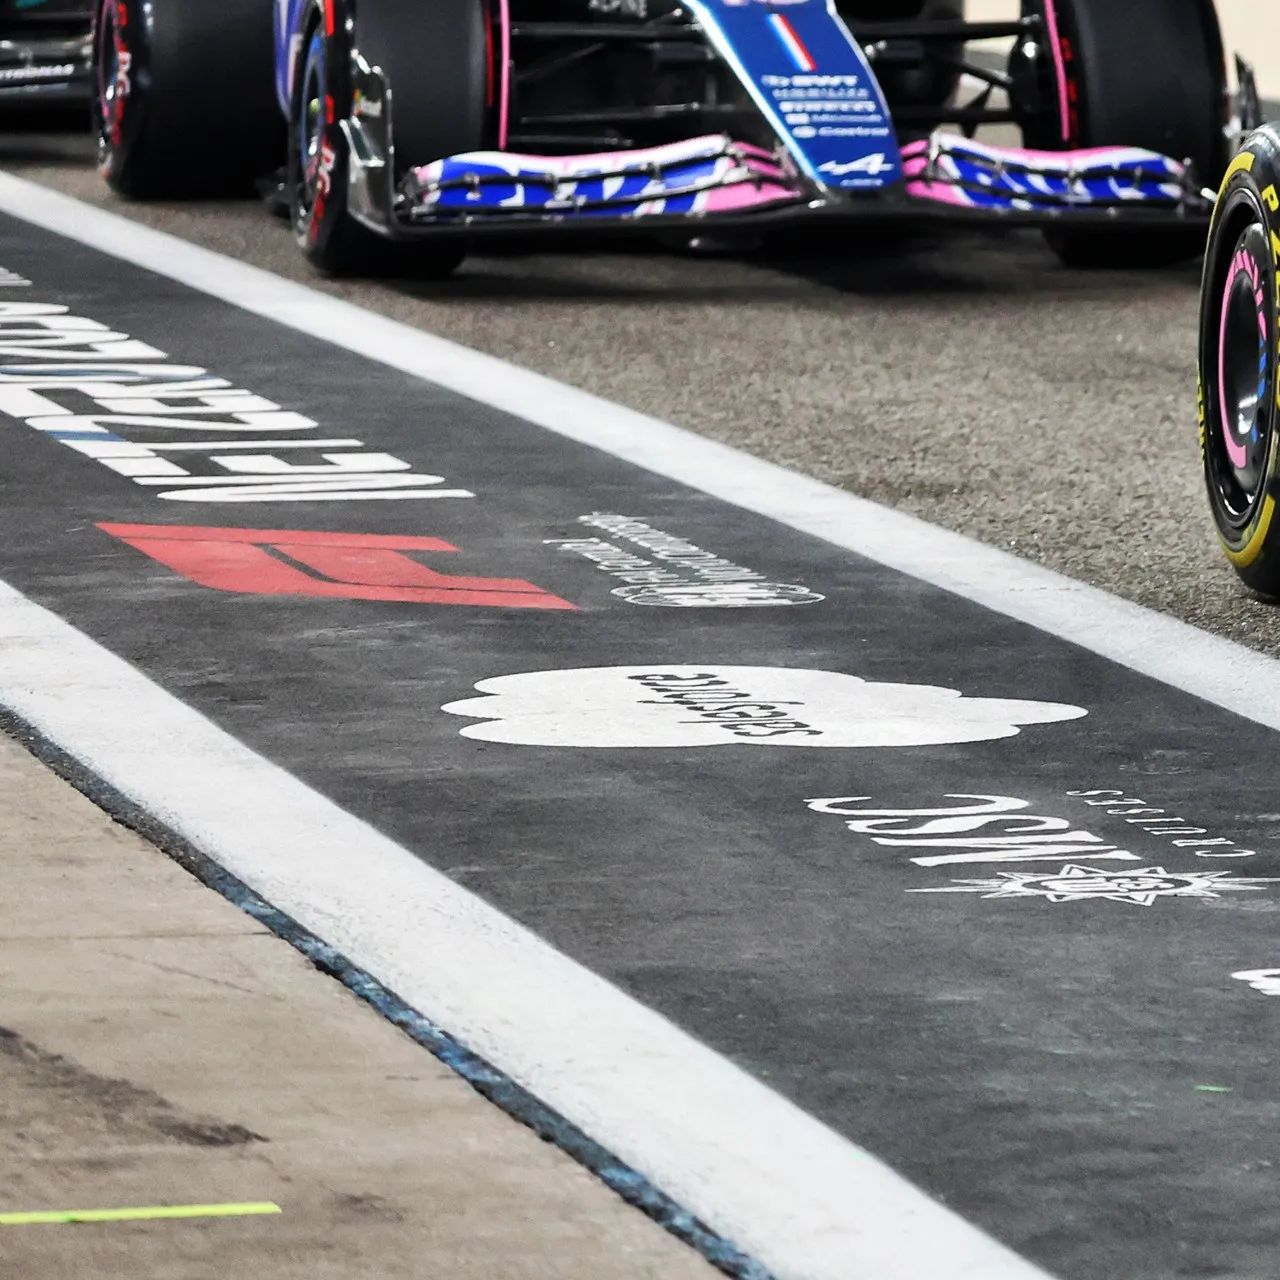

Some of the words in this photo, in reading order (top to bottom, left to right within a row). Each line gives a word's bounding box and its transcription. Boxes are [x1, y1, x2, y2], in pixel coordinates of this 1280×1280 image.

[627, 673, 824, 737] salesforce
[804, 793, 1143, 867] MSC
[1066, 789, 1257, 858] CRUISES
